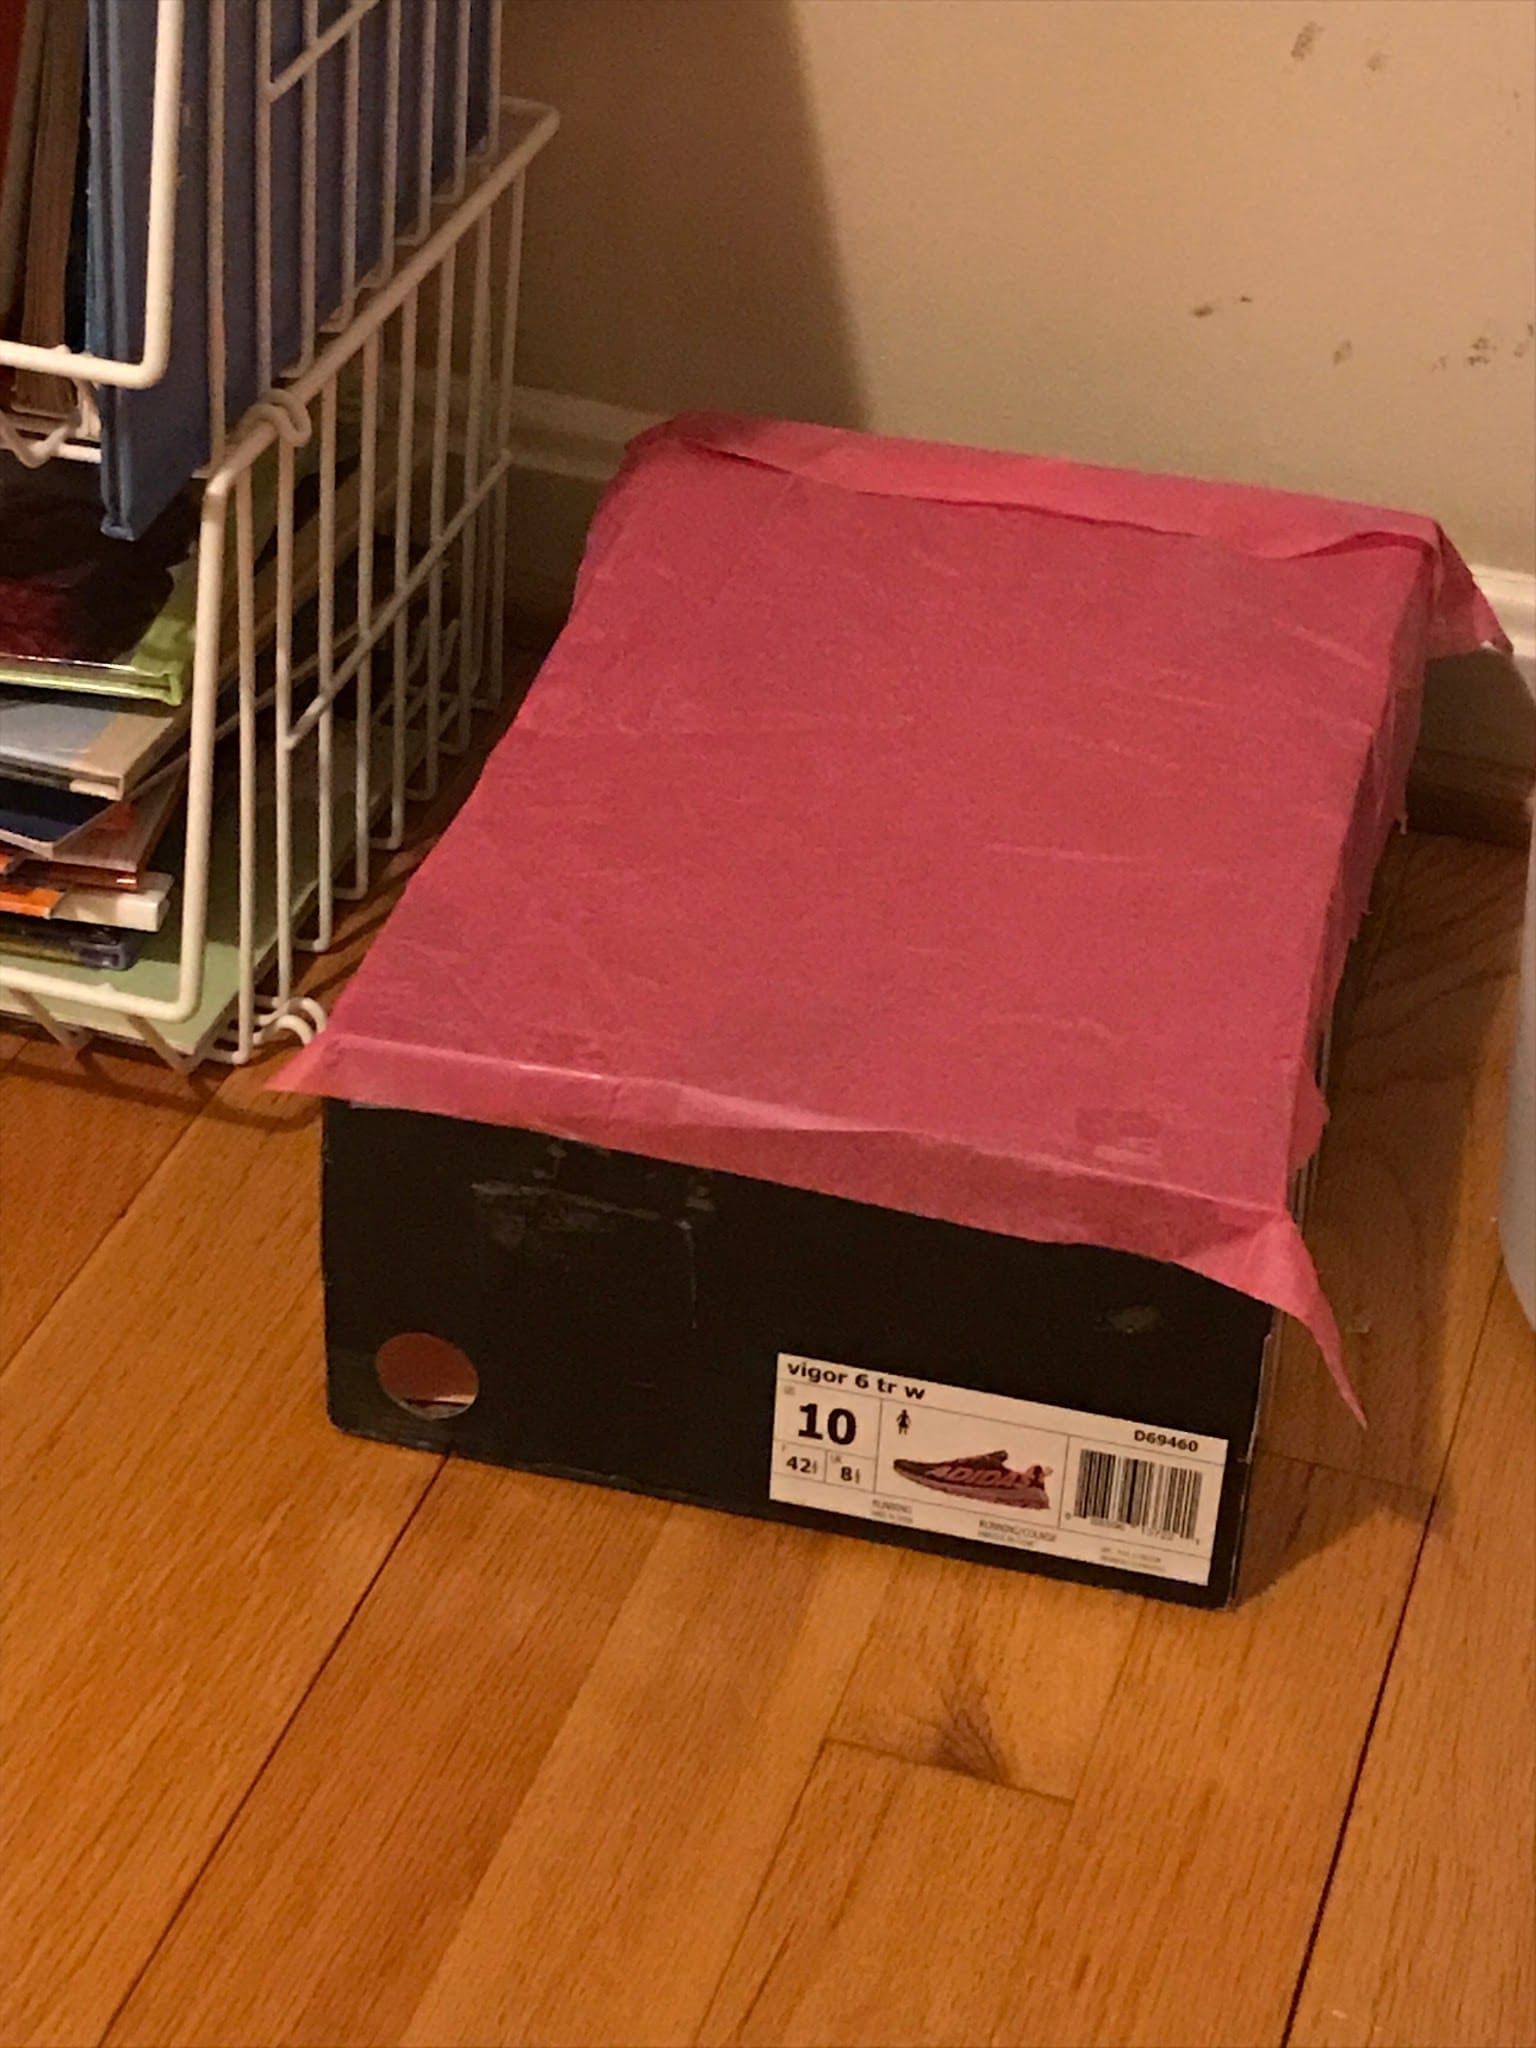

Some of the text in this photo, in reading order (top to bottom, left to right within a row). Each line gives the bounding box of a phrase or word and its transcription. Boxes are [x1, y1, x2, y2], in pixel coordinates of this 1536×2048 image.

[787, 1361, 925, 1400] vigor 6 tr w
[798, 1402, 857, 1446] 10
[1134, 1429, 1199, 1452] D69460
